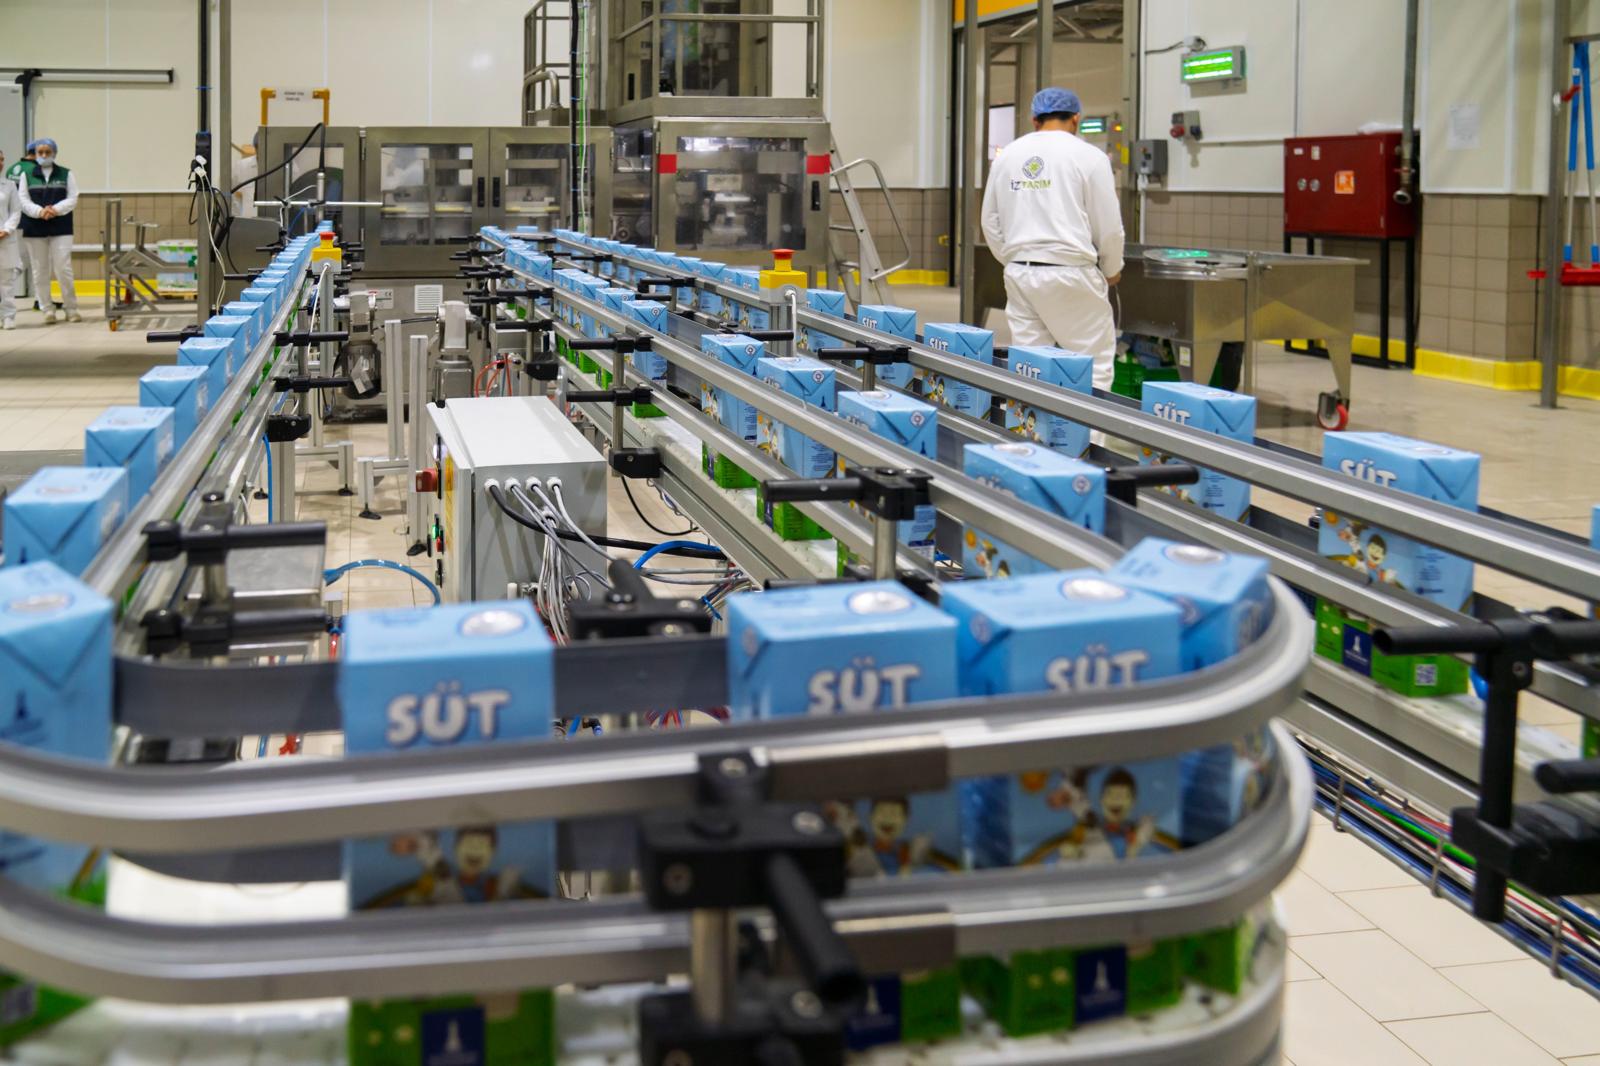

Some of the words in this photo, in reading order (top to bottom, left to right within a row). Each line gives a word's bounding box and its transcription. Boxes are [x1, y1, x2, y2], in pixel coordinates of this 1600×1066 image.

[1153, 402, 1191, 425] SÜT
[807, 656, 921, 716] SÜT
[1045, 643, 1148, 693] SÜT
[386, 679, 511, 746] SÜT
